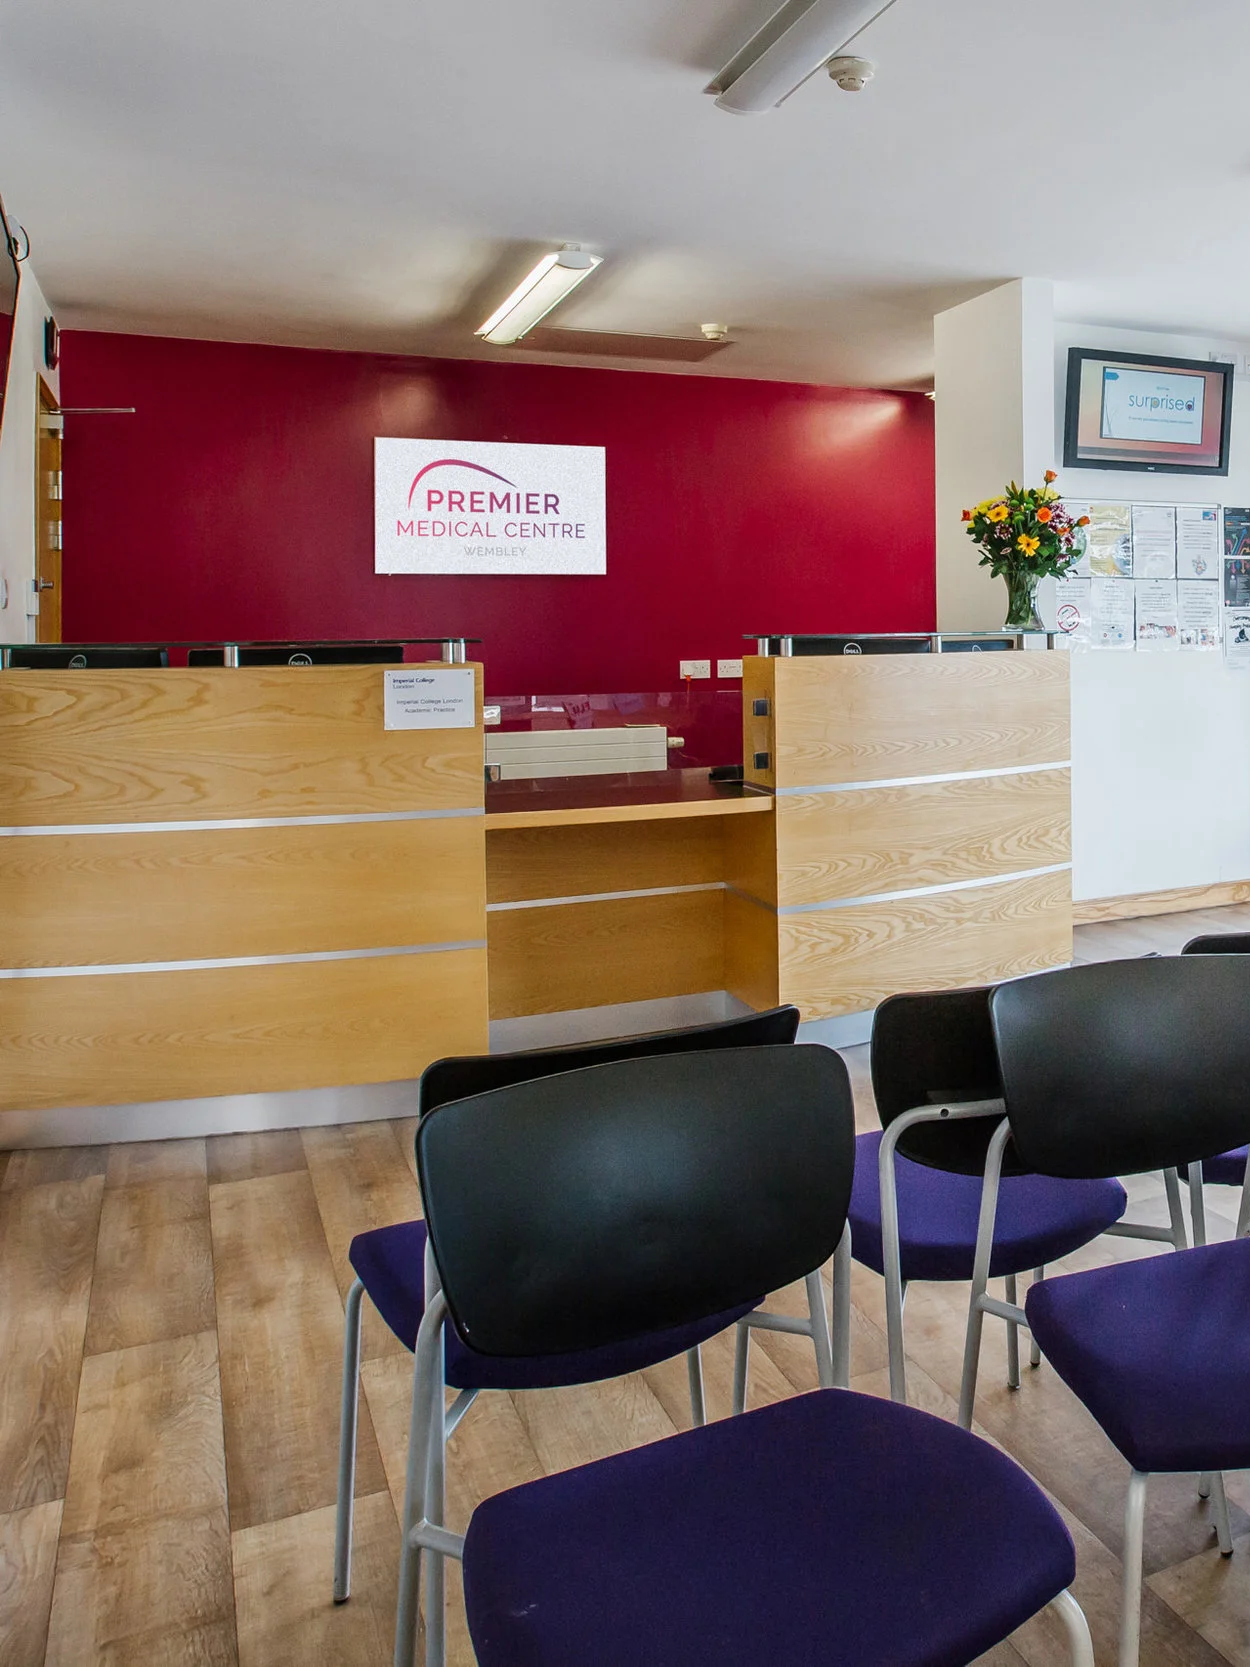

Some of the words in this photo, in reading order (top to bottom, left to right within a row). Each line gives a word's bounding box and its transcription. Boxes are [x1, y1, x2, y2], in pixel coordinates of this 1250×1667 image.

[1128, 394, 1195, 412] surprised
[427, 489, 560, 515] PREMIER
[397, 520, 496, 538] MEDICAL
[504, 522, 586, 538] CENTRE
[464, 546, 527, 557] WEMBLEY
